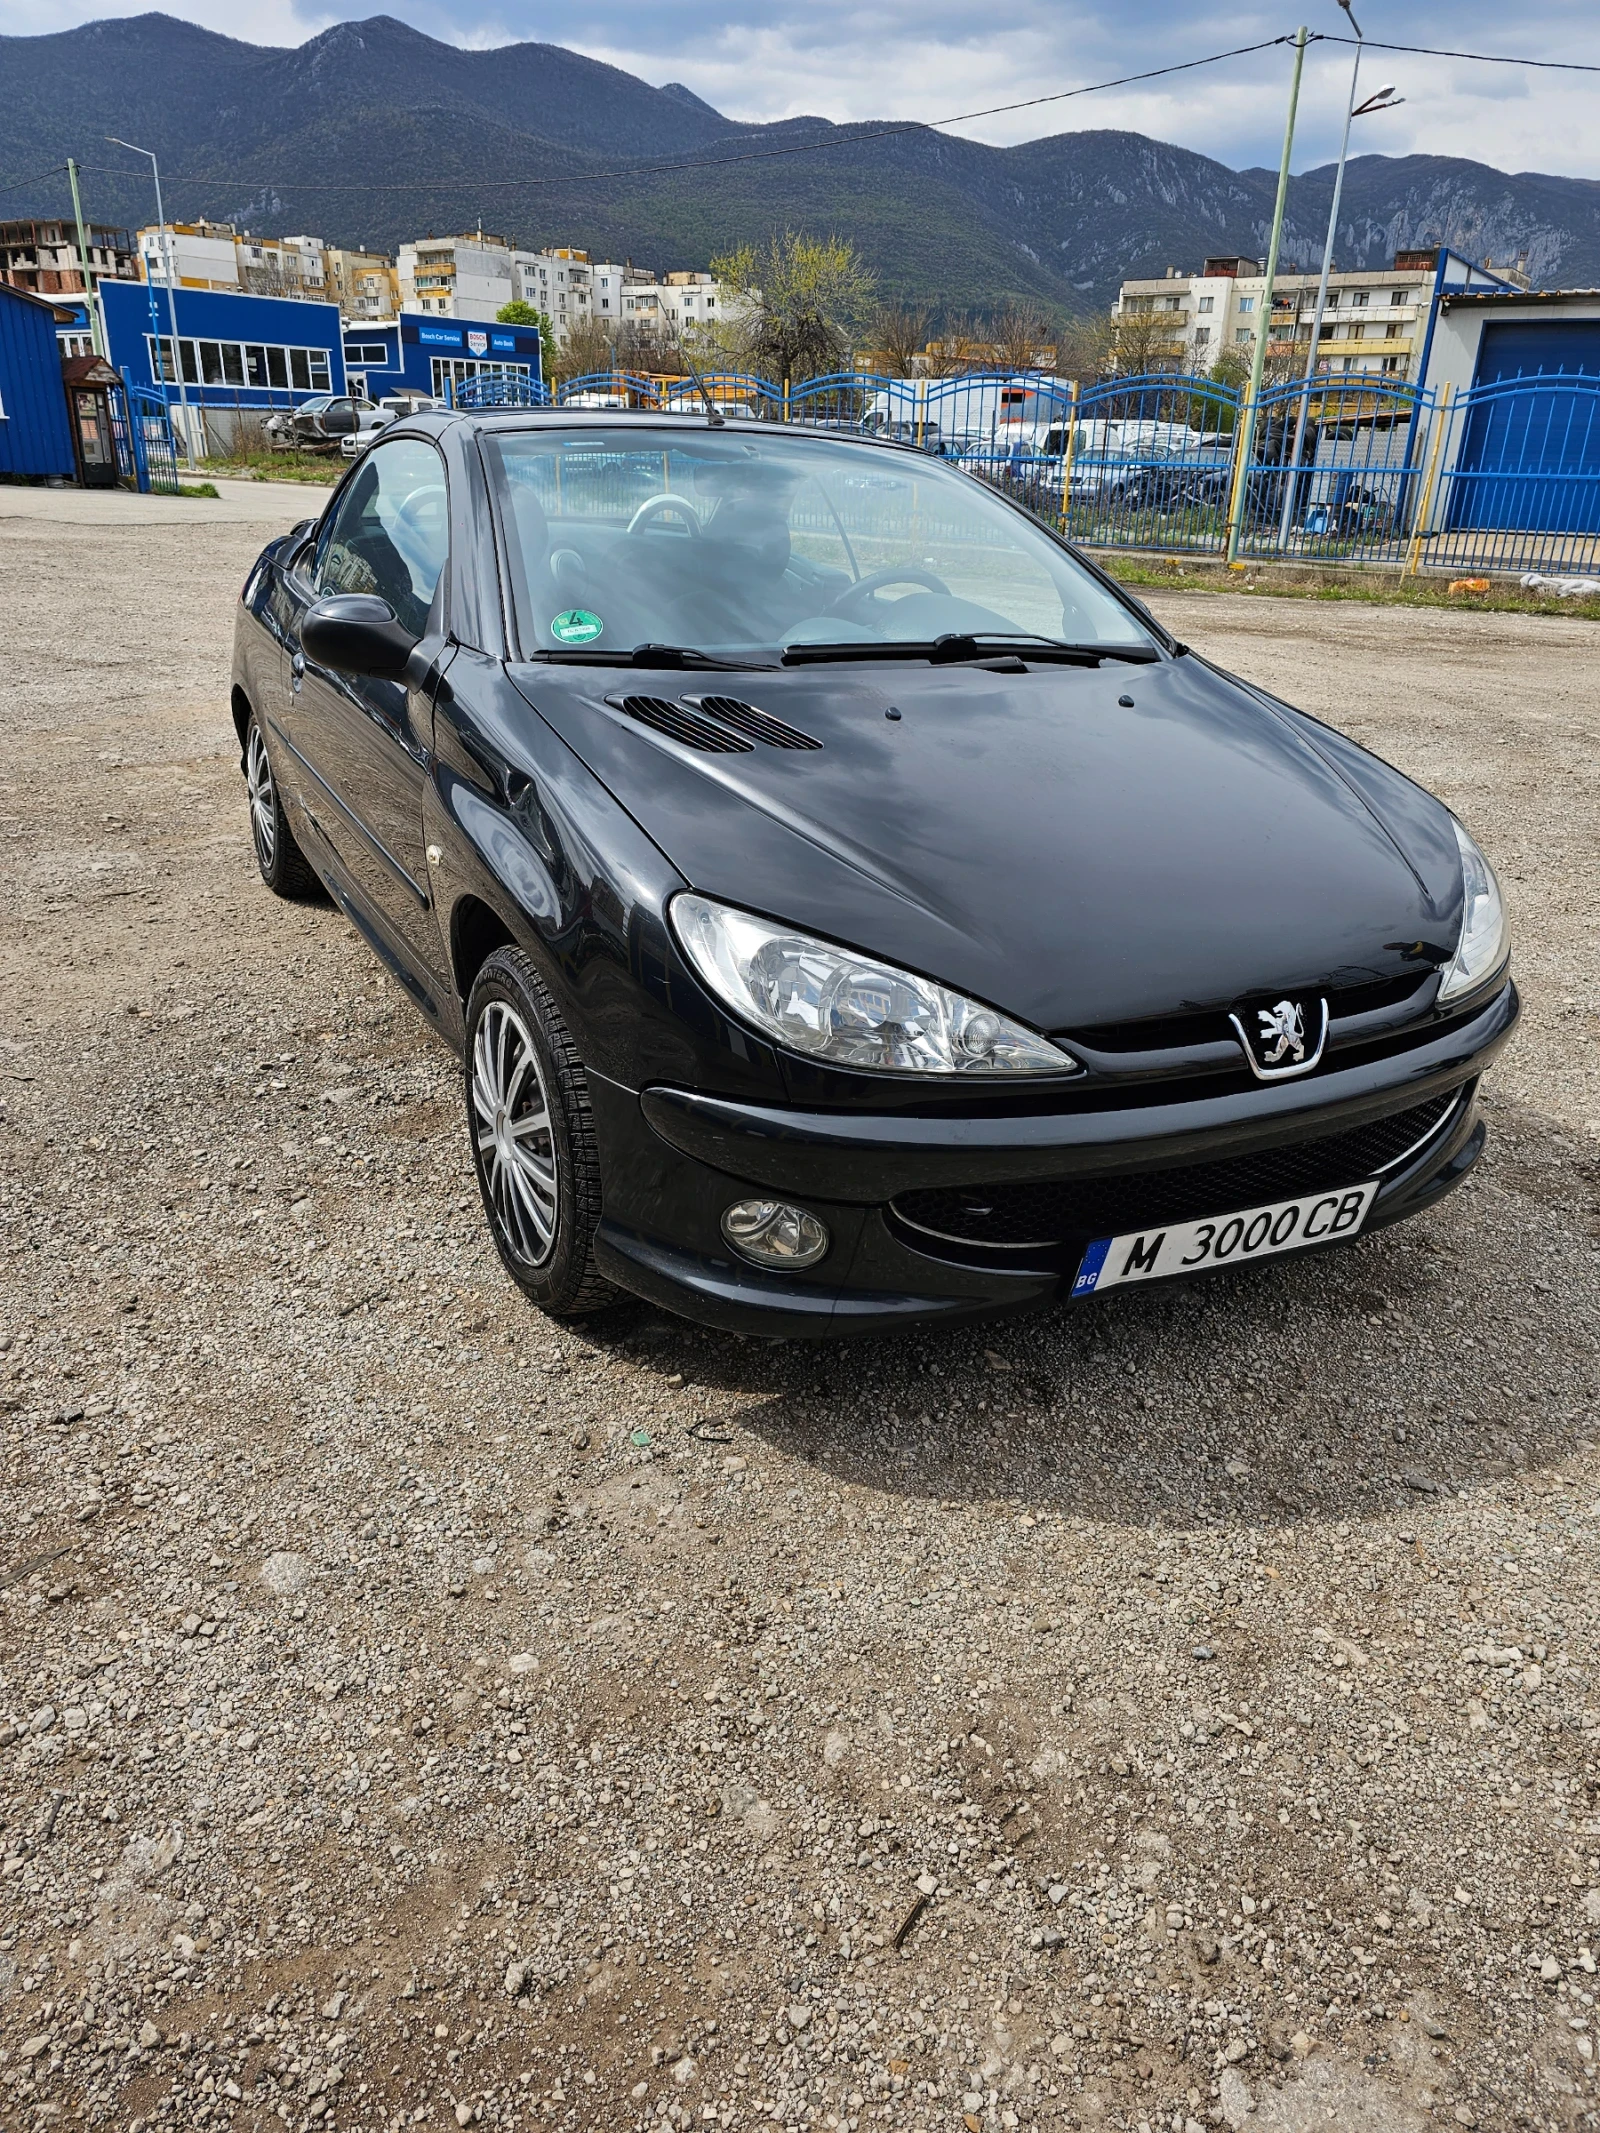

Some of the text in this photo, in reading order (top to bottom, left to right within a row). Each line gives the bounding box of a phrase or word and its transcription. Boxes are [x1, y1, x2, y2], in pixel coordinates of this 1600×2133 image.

[436, 333, 444, 341] Car
[444, 334, 460, 342] Service
[470, 333, 485, 341] BOSCH
[569, 612, 583, 625] 4
[1121, 1233, 1166, 1276] M
[1076, 1272, 1096, 1288] BG
